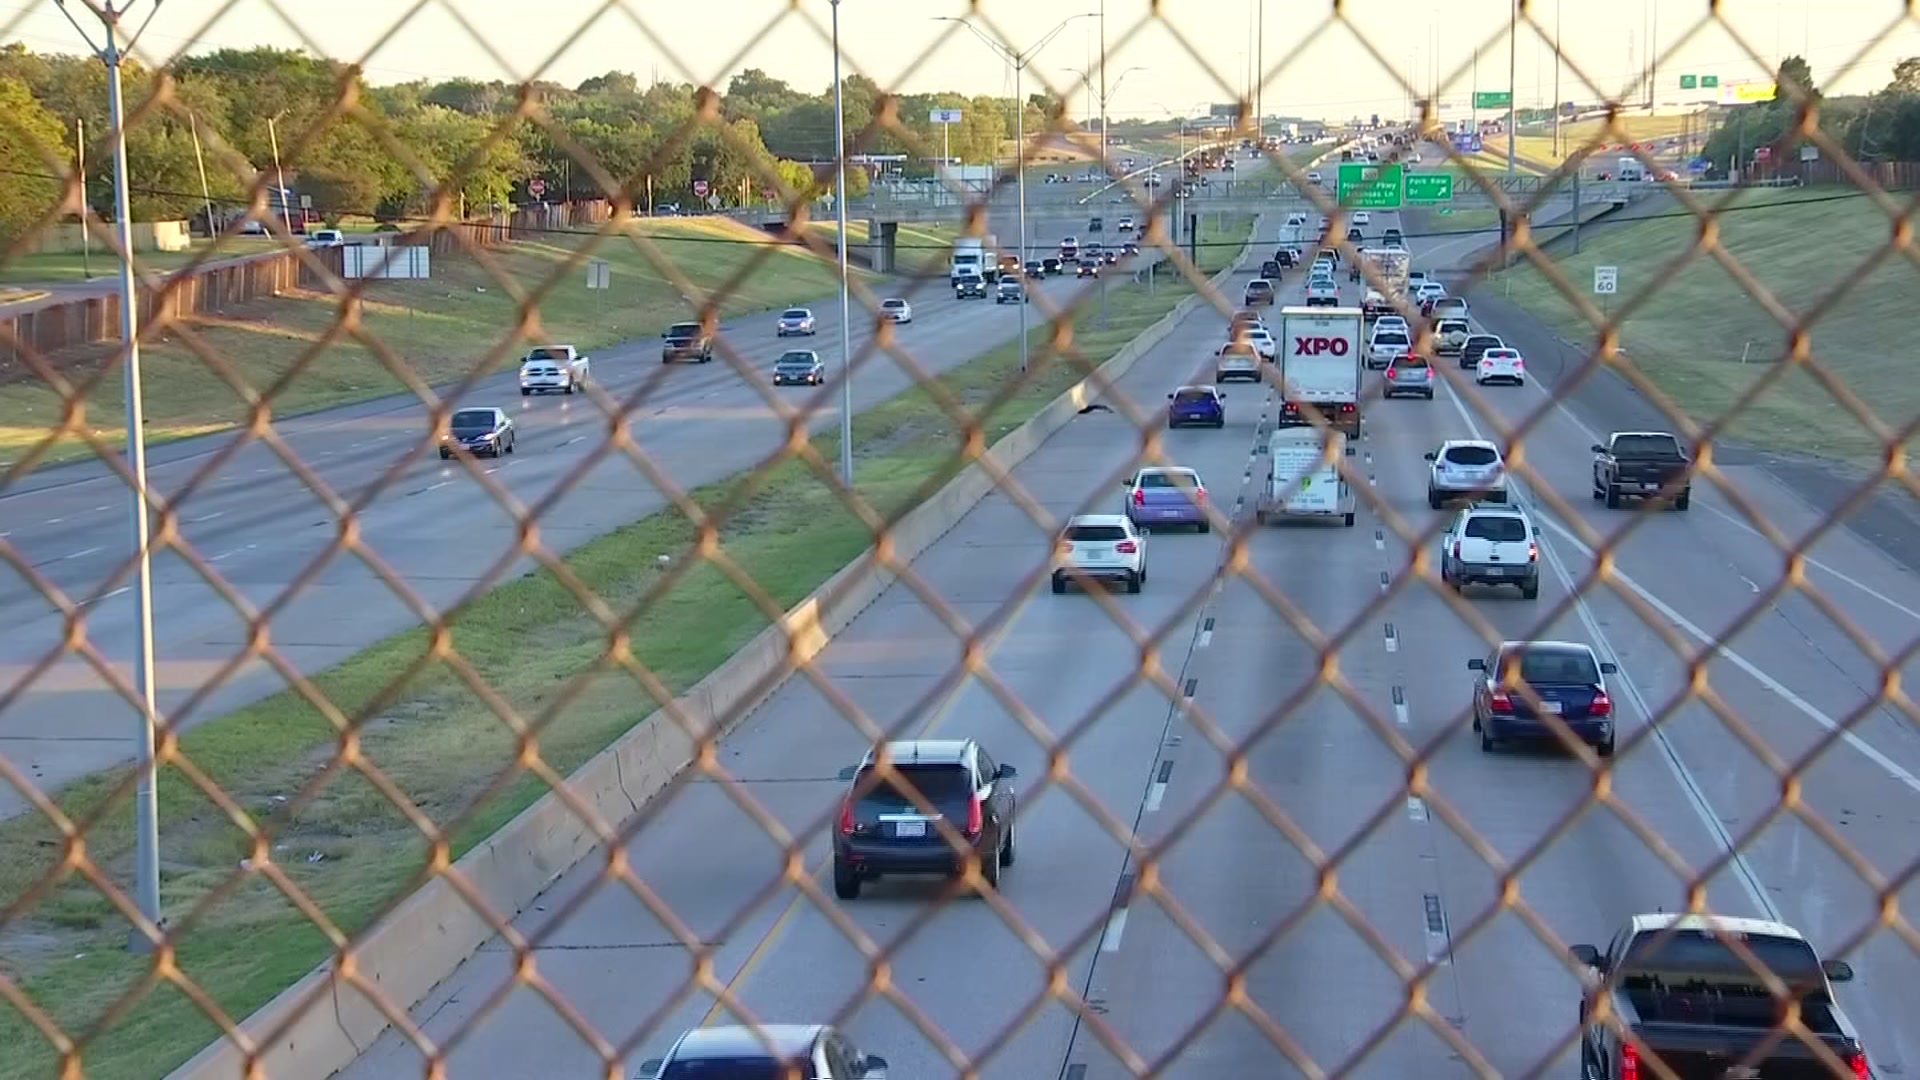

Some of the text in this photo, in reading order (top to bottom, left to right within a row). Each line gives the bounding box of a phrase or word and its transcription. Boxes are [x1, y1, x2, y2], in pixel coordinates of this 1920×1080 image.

[1376, 182, 1397, 190] Pkwy
[1598, 282, 1613, 291] 60
[1295, 337, 1349, 356] XPO
